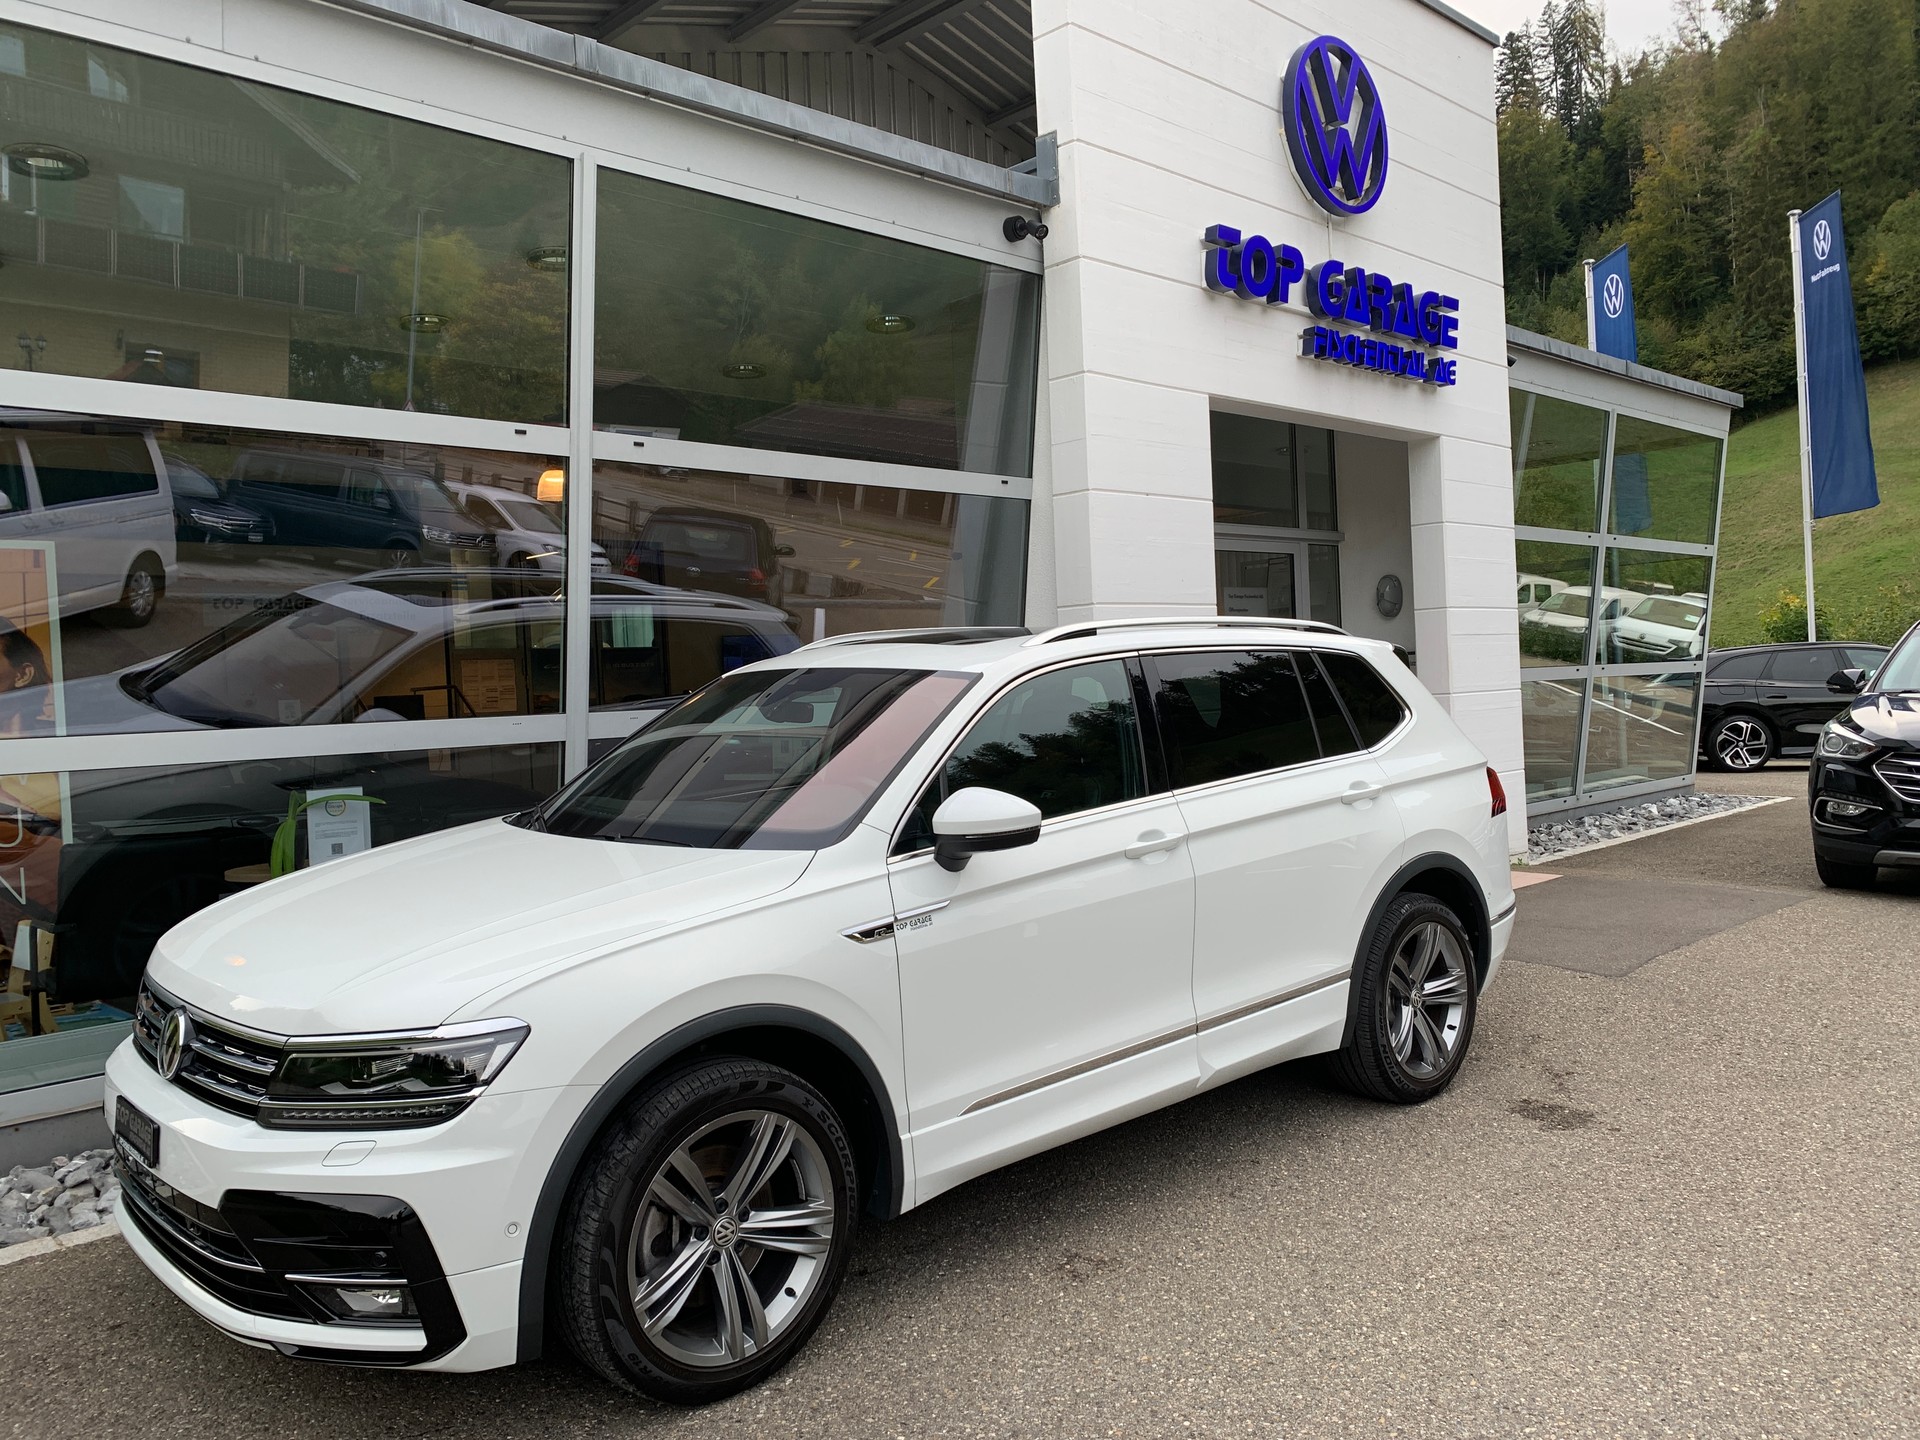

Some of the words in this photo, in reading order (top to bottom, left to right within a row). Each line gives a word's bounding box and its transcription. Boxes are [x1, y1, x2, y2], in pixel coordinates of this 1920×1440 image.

[1205, 224, 1304, 304] TOP
[1306, 260, 1459, 350] GARAGE
[1427, 357, 1457, 386] AG
[896, 921, 908, 931] TOP
[909, 914, 932, 926] GARAGE
